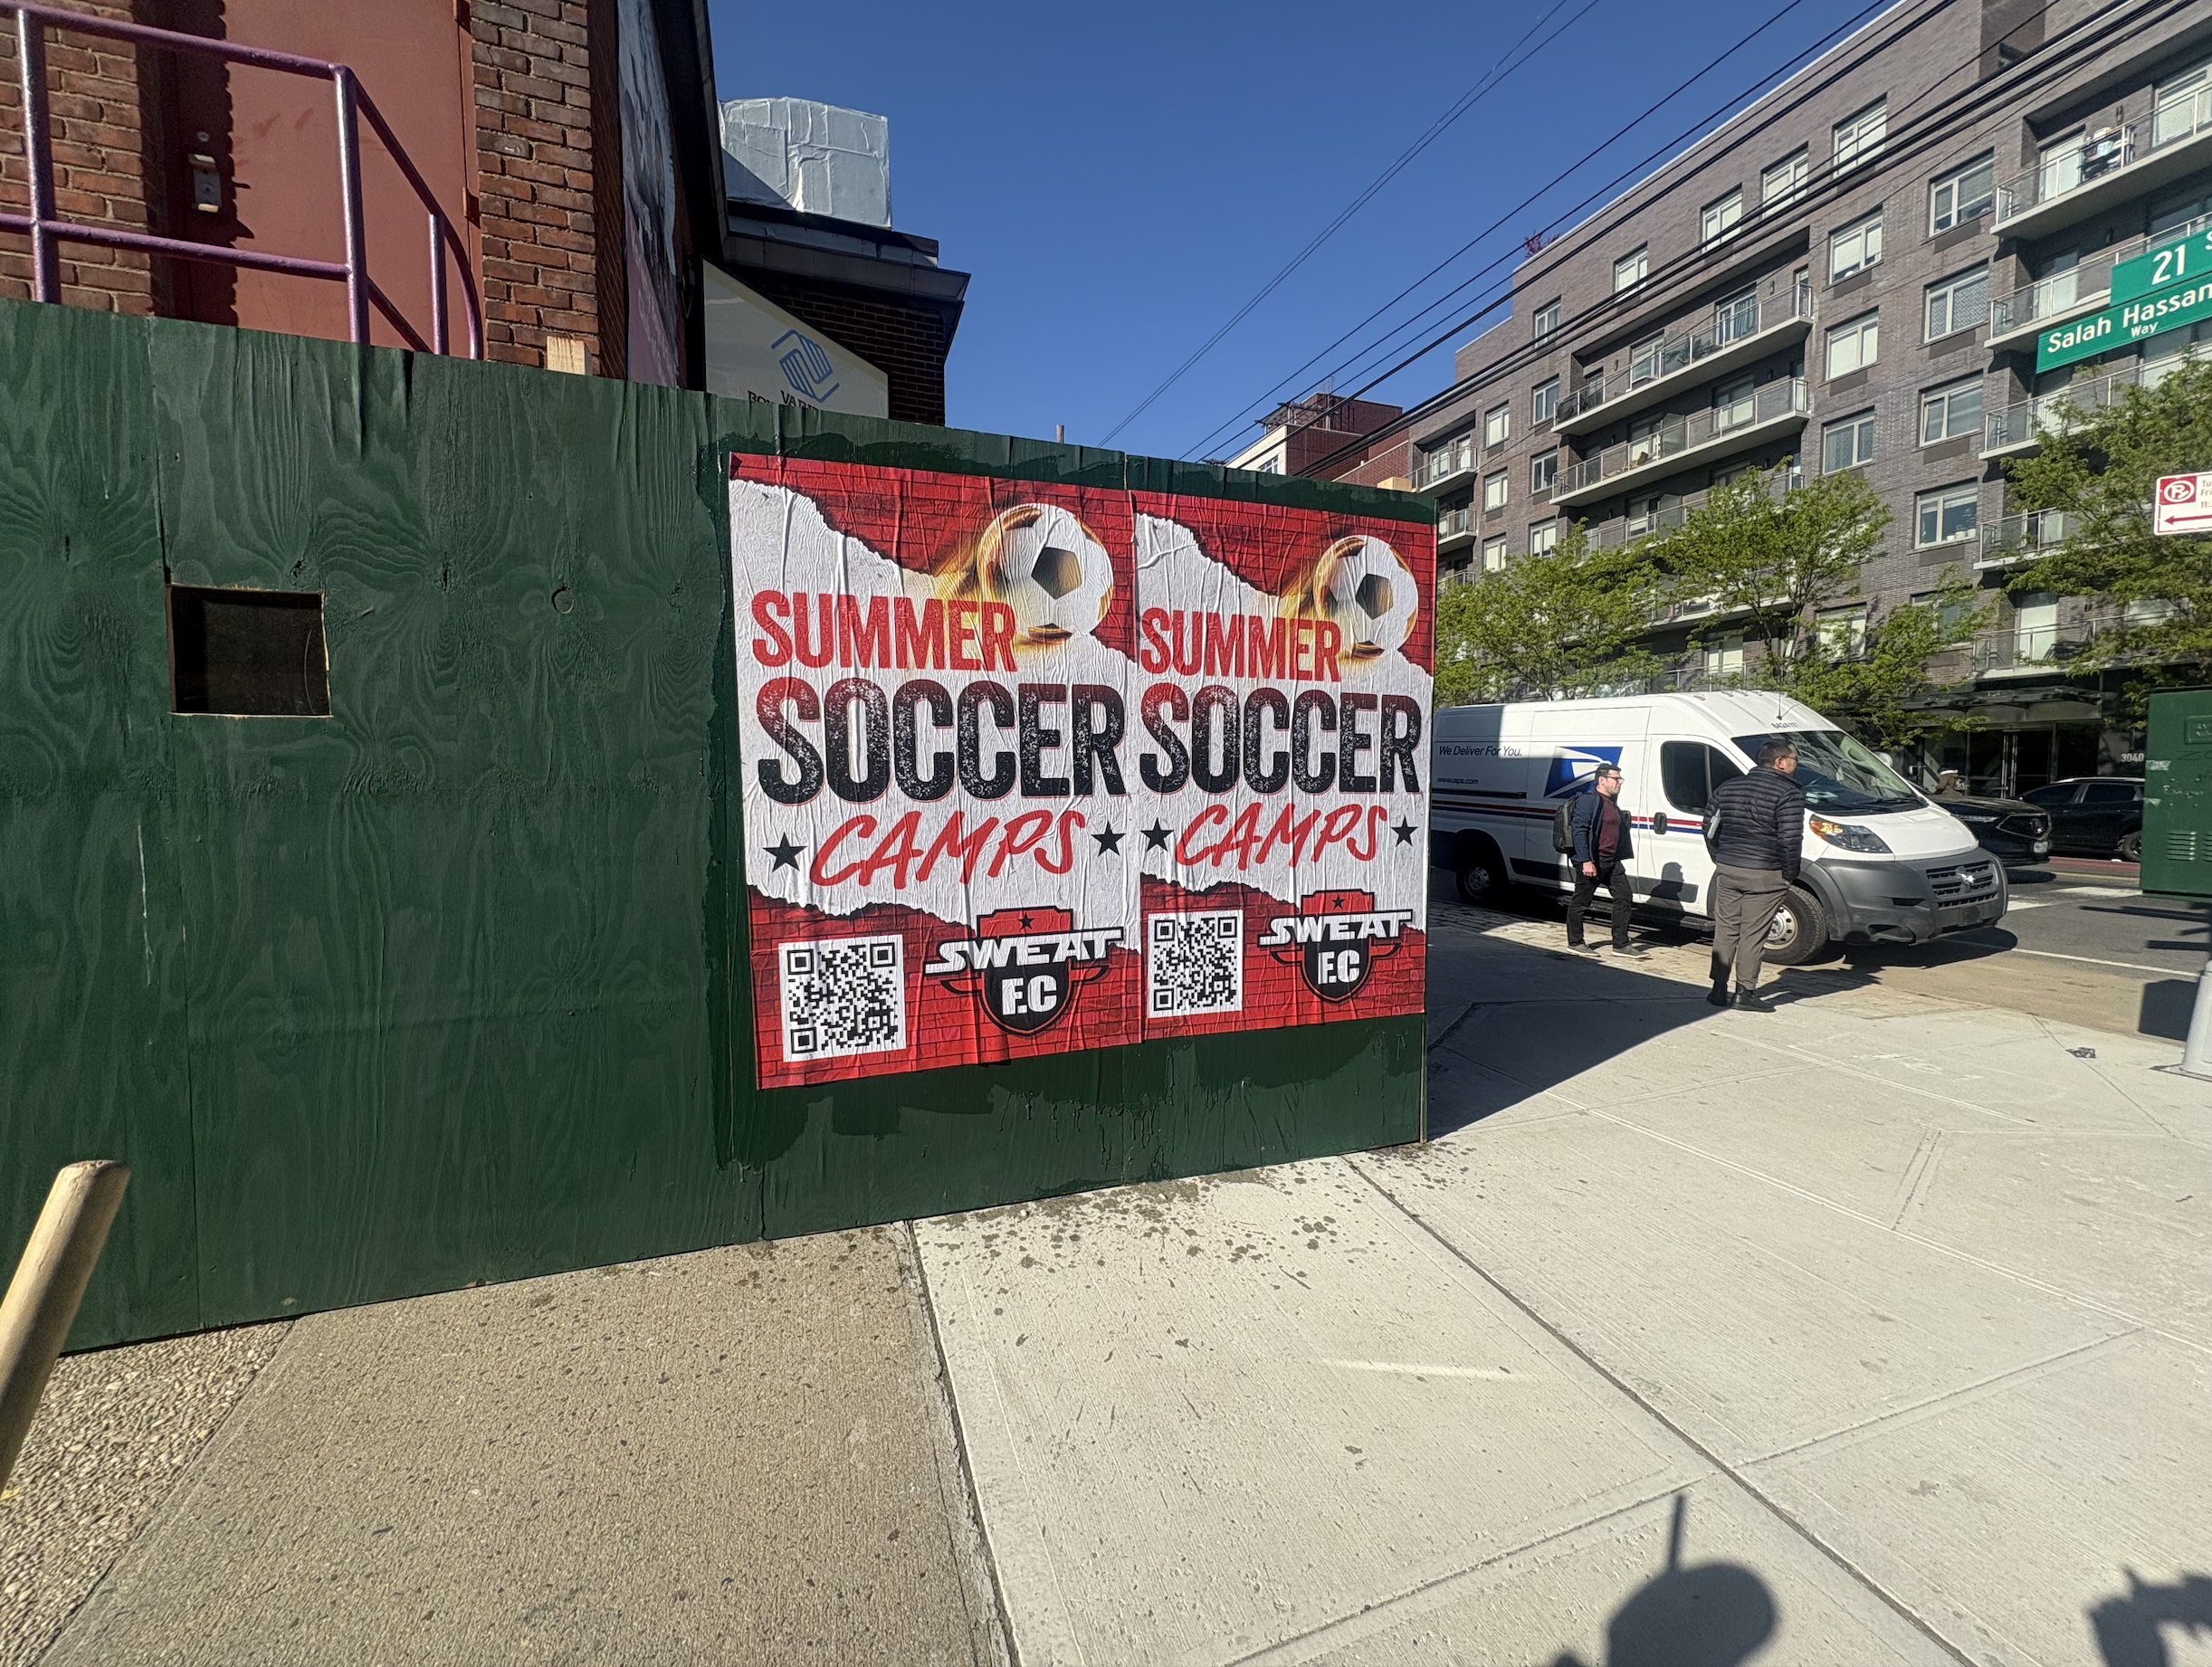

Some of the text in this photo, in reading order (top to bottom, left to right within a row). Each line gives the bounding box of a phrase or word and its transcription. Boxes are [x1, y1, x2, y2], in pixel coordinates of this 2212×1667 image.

[2151, 243, 2187, 286] 21
[2047, 317, 2112, 353] Salah
[2131, 321, 2159, 338] Way
[751, 589, 1018, 672] SUMMER
[1140, 607, 1341, 682] SUMMER
[756, 676, 1128, 806] SOCCER
[1139, 681, 1422, 795] SOCCER
[1439, 746, 1452, 757] We
[1453, 745, 1484, 757] Deliver
[1485, 746, 1502, 757] For
[809, 810, 1086, 890] CAMPS
[1176, 802, 1388, 871] CAMPS
[925, 928, 1123, 976] SWEAT
[1258, 910, 1413, 948] SWEAT
